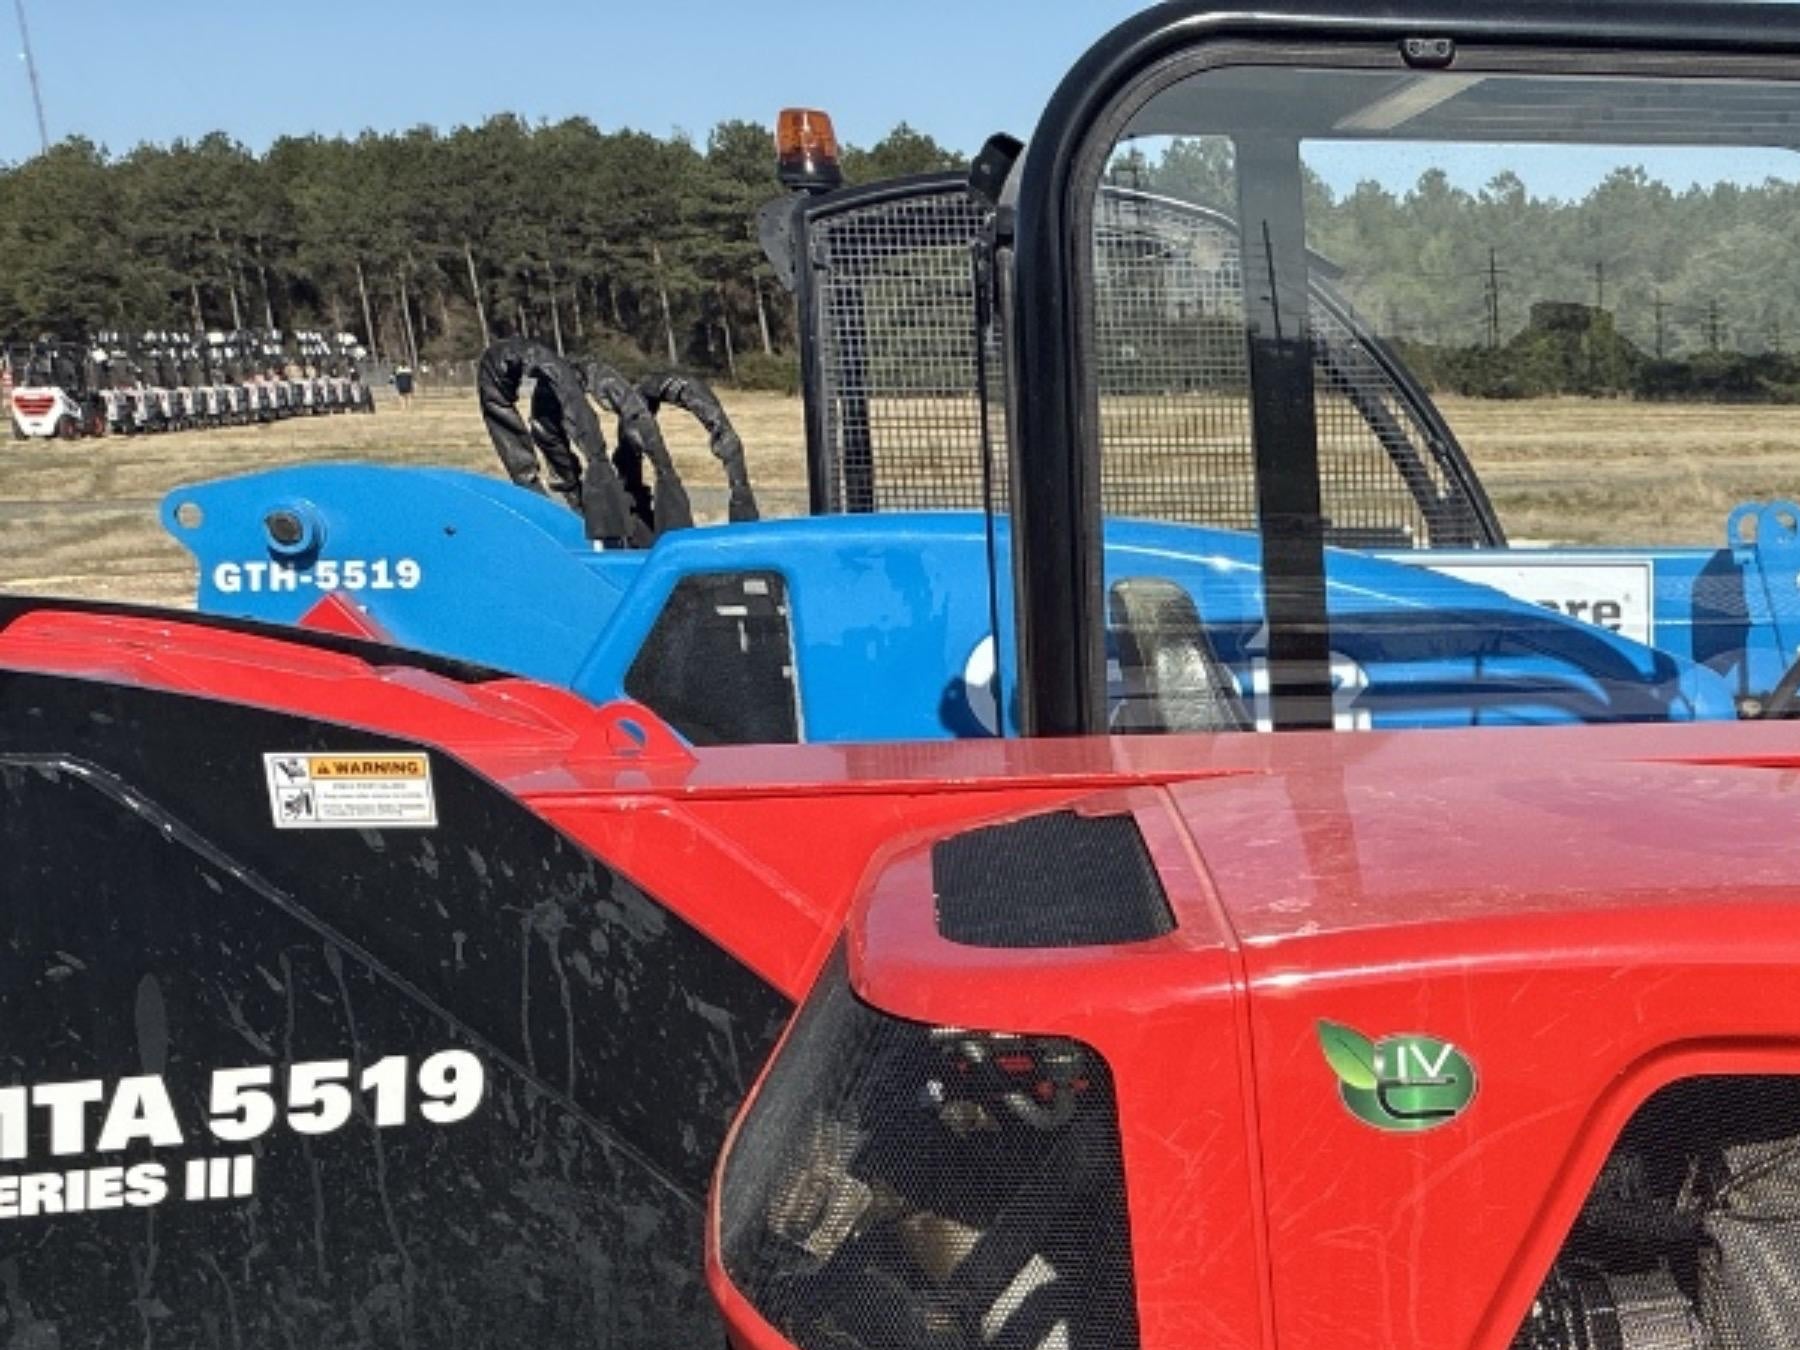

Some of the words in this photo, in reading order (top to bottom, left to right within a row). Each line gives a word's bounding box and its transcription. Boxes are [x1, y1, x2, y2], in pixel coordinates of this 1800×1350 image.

[213, 557, 422, 593] GTH-5519
[333, 761, 419, 775] WARNING
[1396, 1042, 1455, 1080] IV
[0, 1073, 185, 1161] TA
[208, 1048, 485, 1142] 5519
[185, 1154, 255, 1202] III
